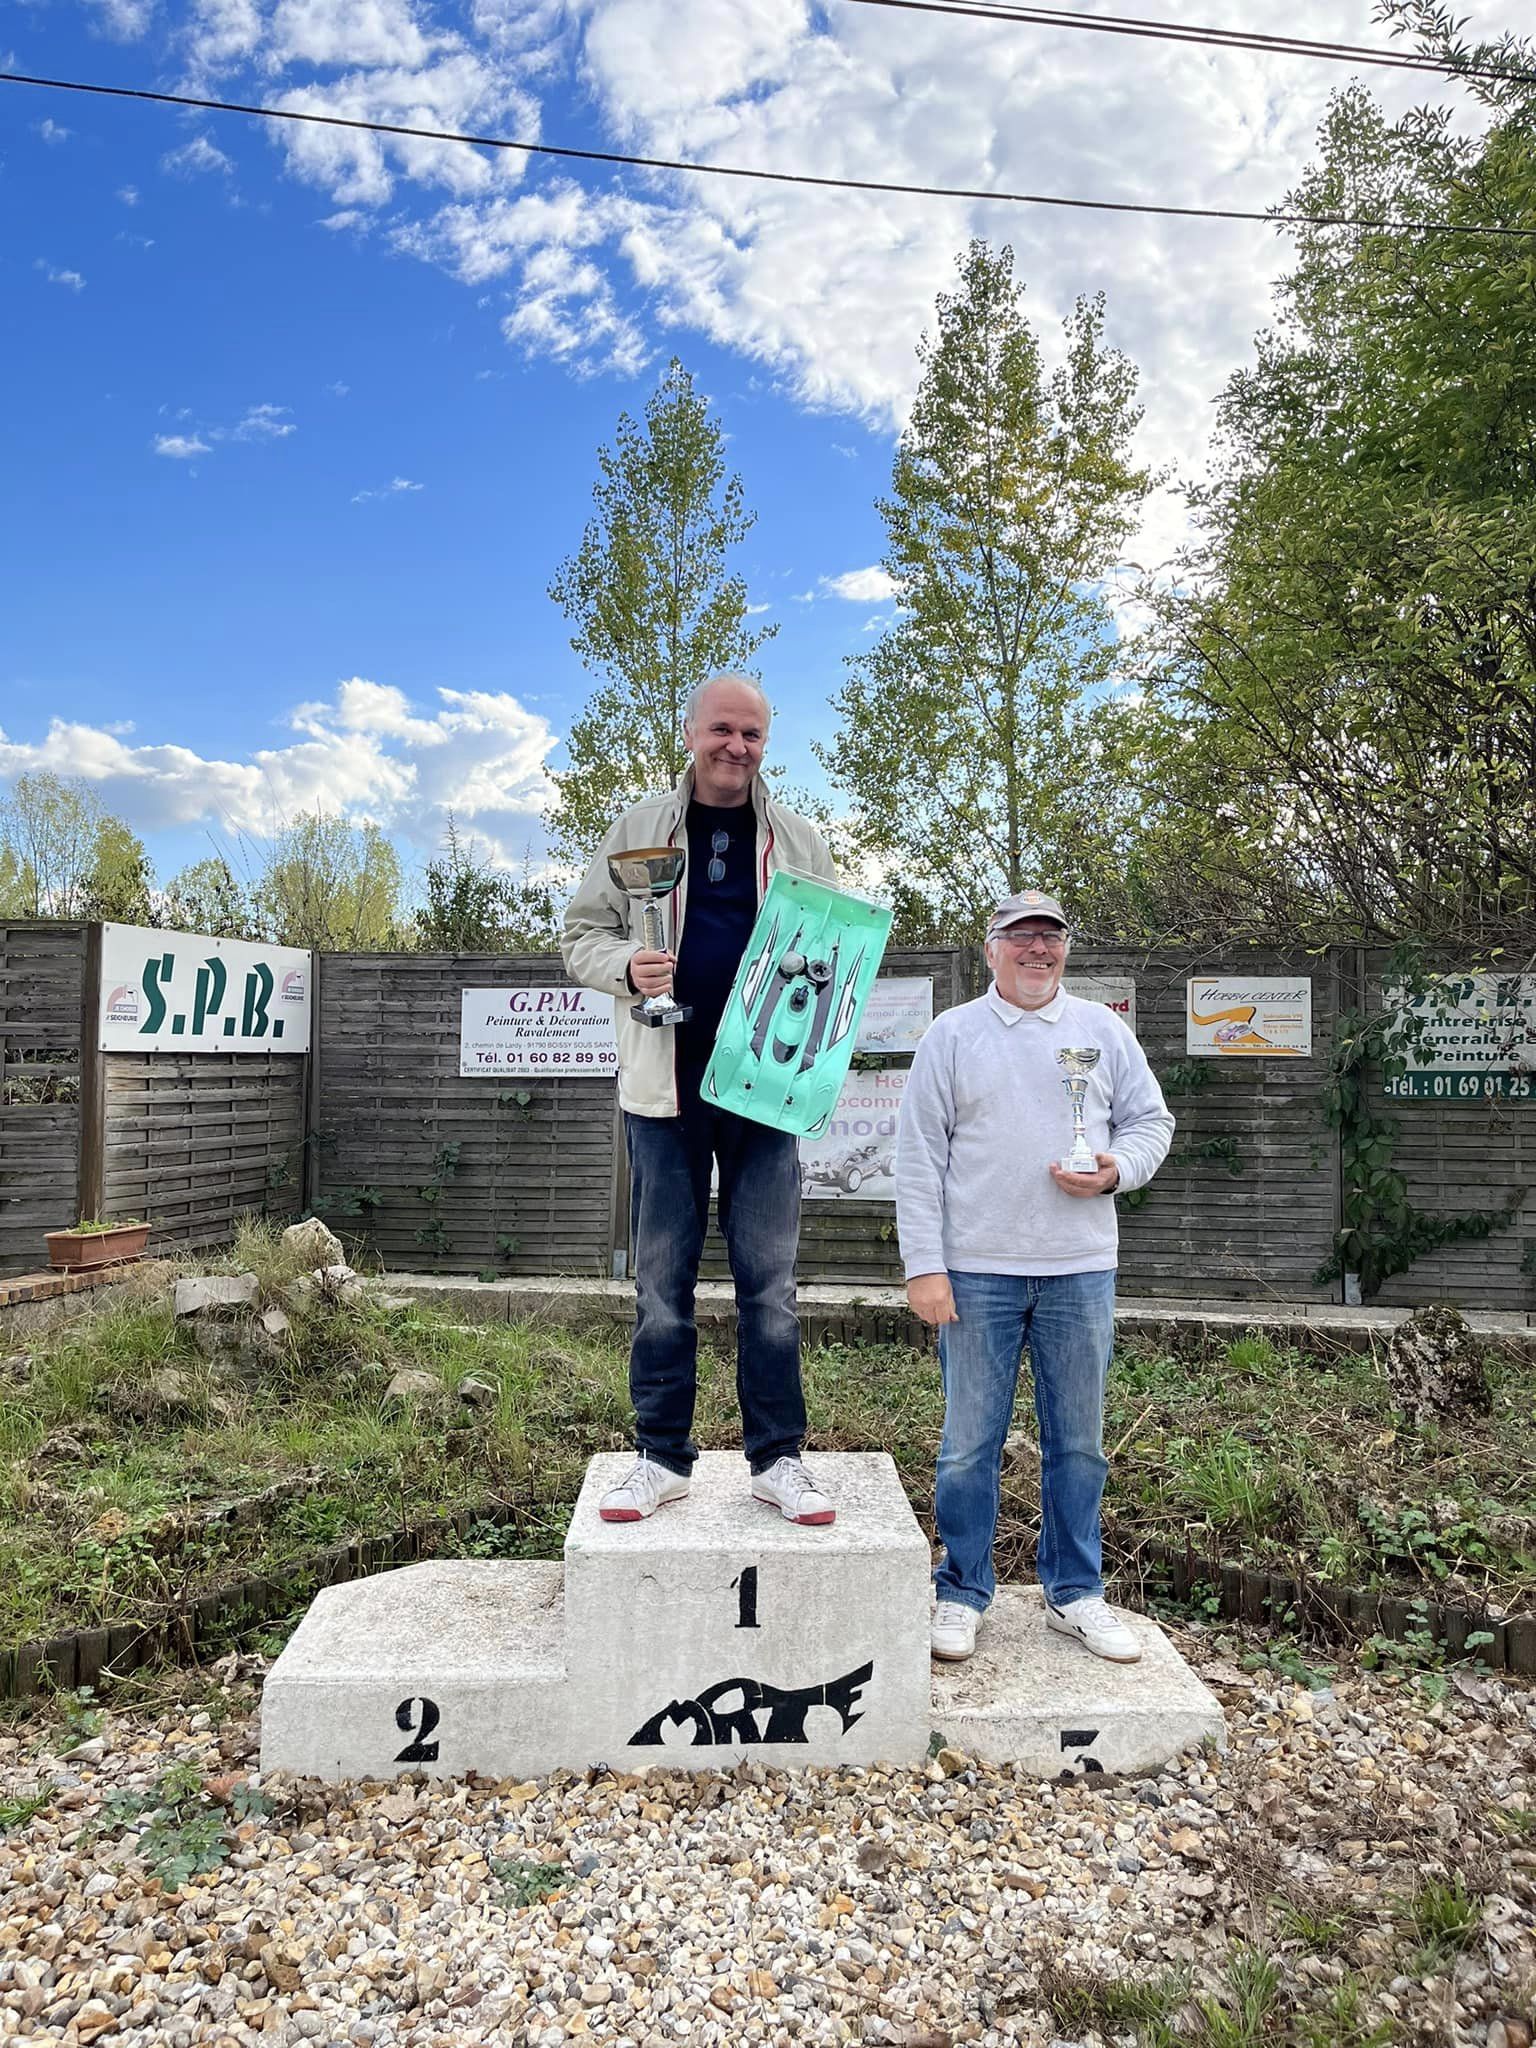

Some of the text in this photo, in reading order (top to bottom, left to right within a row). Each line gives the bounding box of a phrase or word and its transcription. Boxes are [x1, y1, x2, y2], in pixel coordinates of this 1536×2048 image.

[139, 953, 284, 1038] S.P.B.
[509, 991, 586, 1013] G.P.M.
[1200, 989, 1308, 1001] HOBBY CENTER
[486, 1015, 610, 1026] Peinture & Décoration
[515, 1027, 580, 1038] Ravalement
[476, 1052, 617, 1063] Tél. 01 60 82 89 90
[1433, 1050, 1520, 1061] Peinture
[1391, 1075, 1418, 1095] Tél.
[1434, 1076, 1451, 1096] 01
[1459, 1076, 1479, 1096] 69
[1484, 1076, 1503, 1096] 01
[1510, 1077, 1529, 1096] 25
[730, 1566, 761, 1628] 1
[393, 1697, 440, 1762] 2
